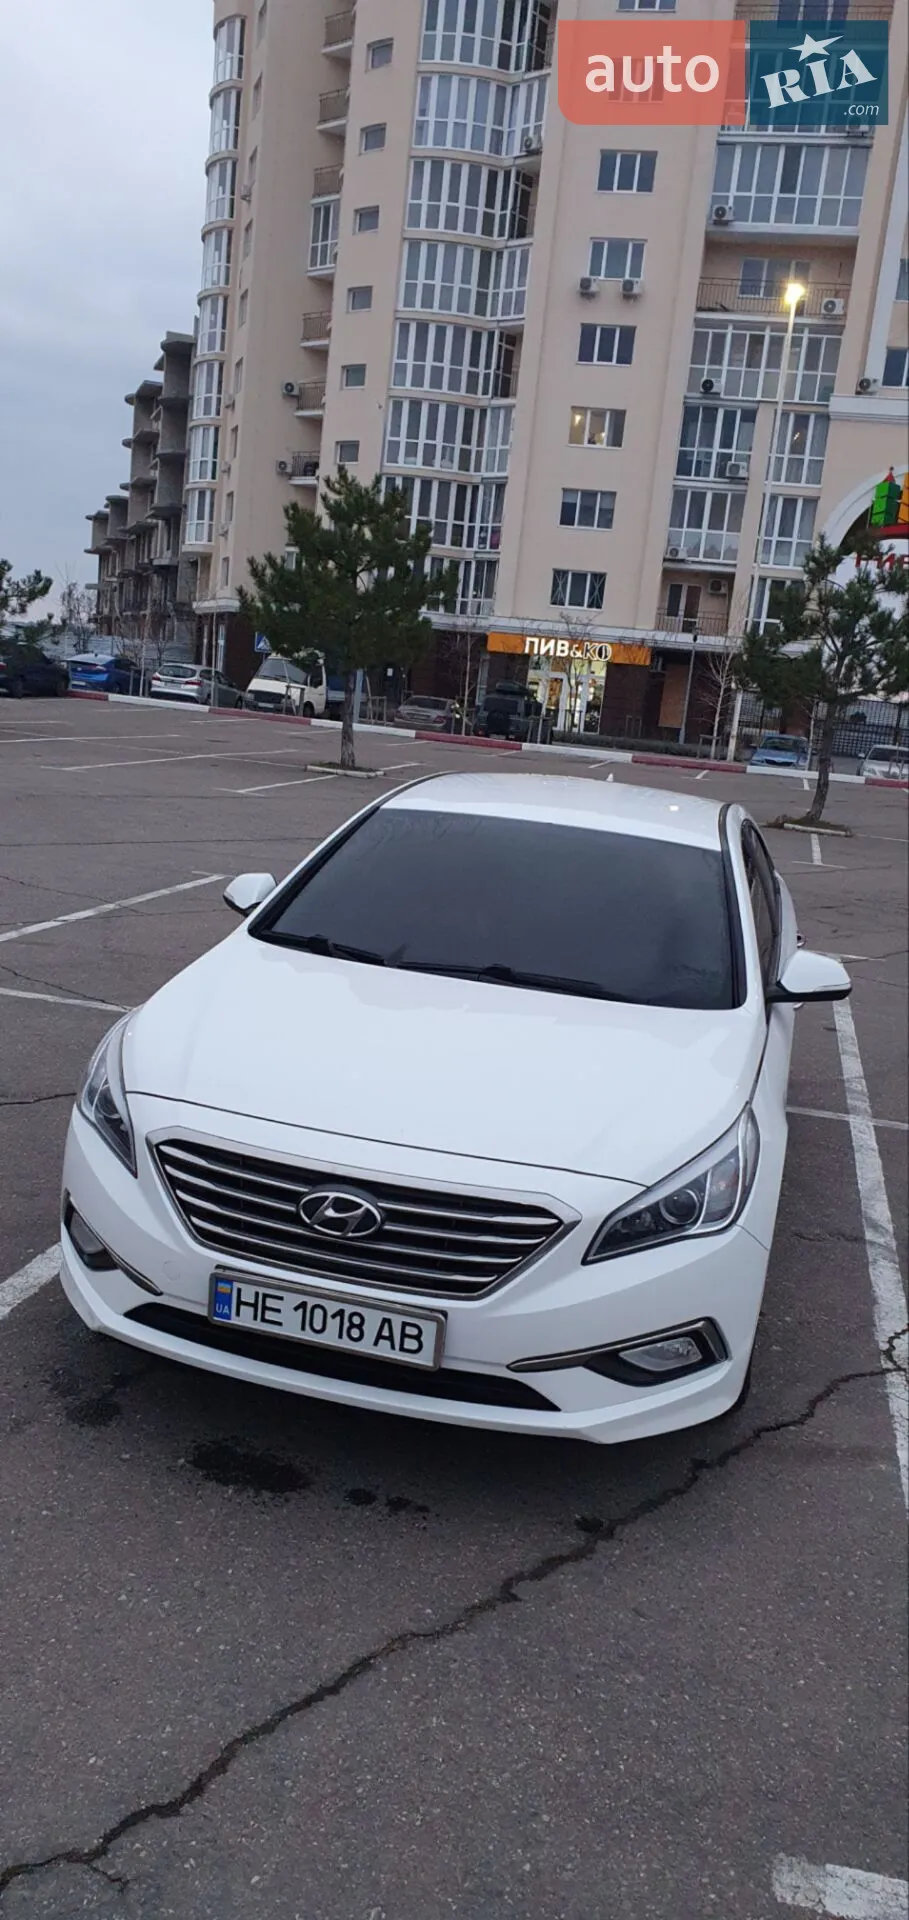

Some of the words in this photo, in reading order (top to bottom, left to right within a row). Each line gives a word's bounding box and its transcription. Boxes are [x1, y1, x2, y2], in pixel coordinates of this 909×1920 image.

[215, 1303, 230, 1316] UA
[235, 1287, 284, 1327] HE
[292, 1300, 366, 1343] 1018
[373, 1317, 424, 1355] AB
